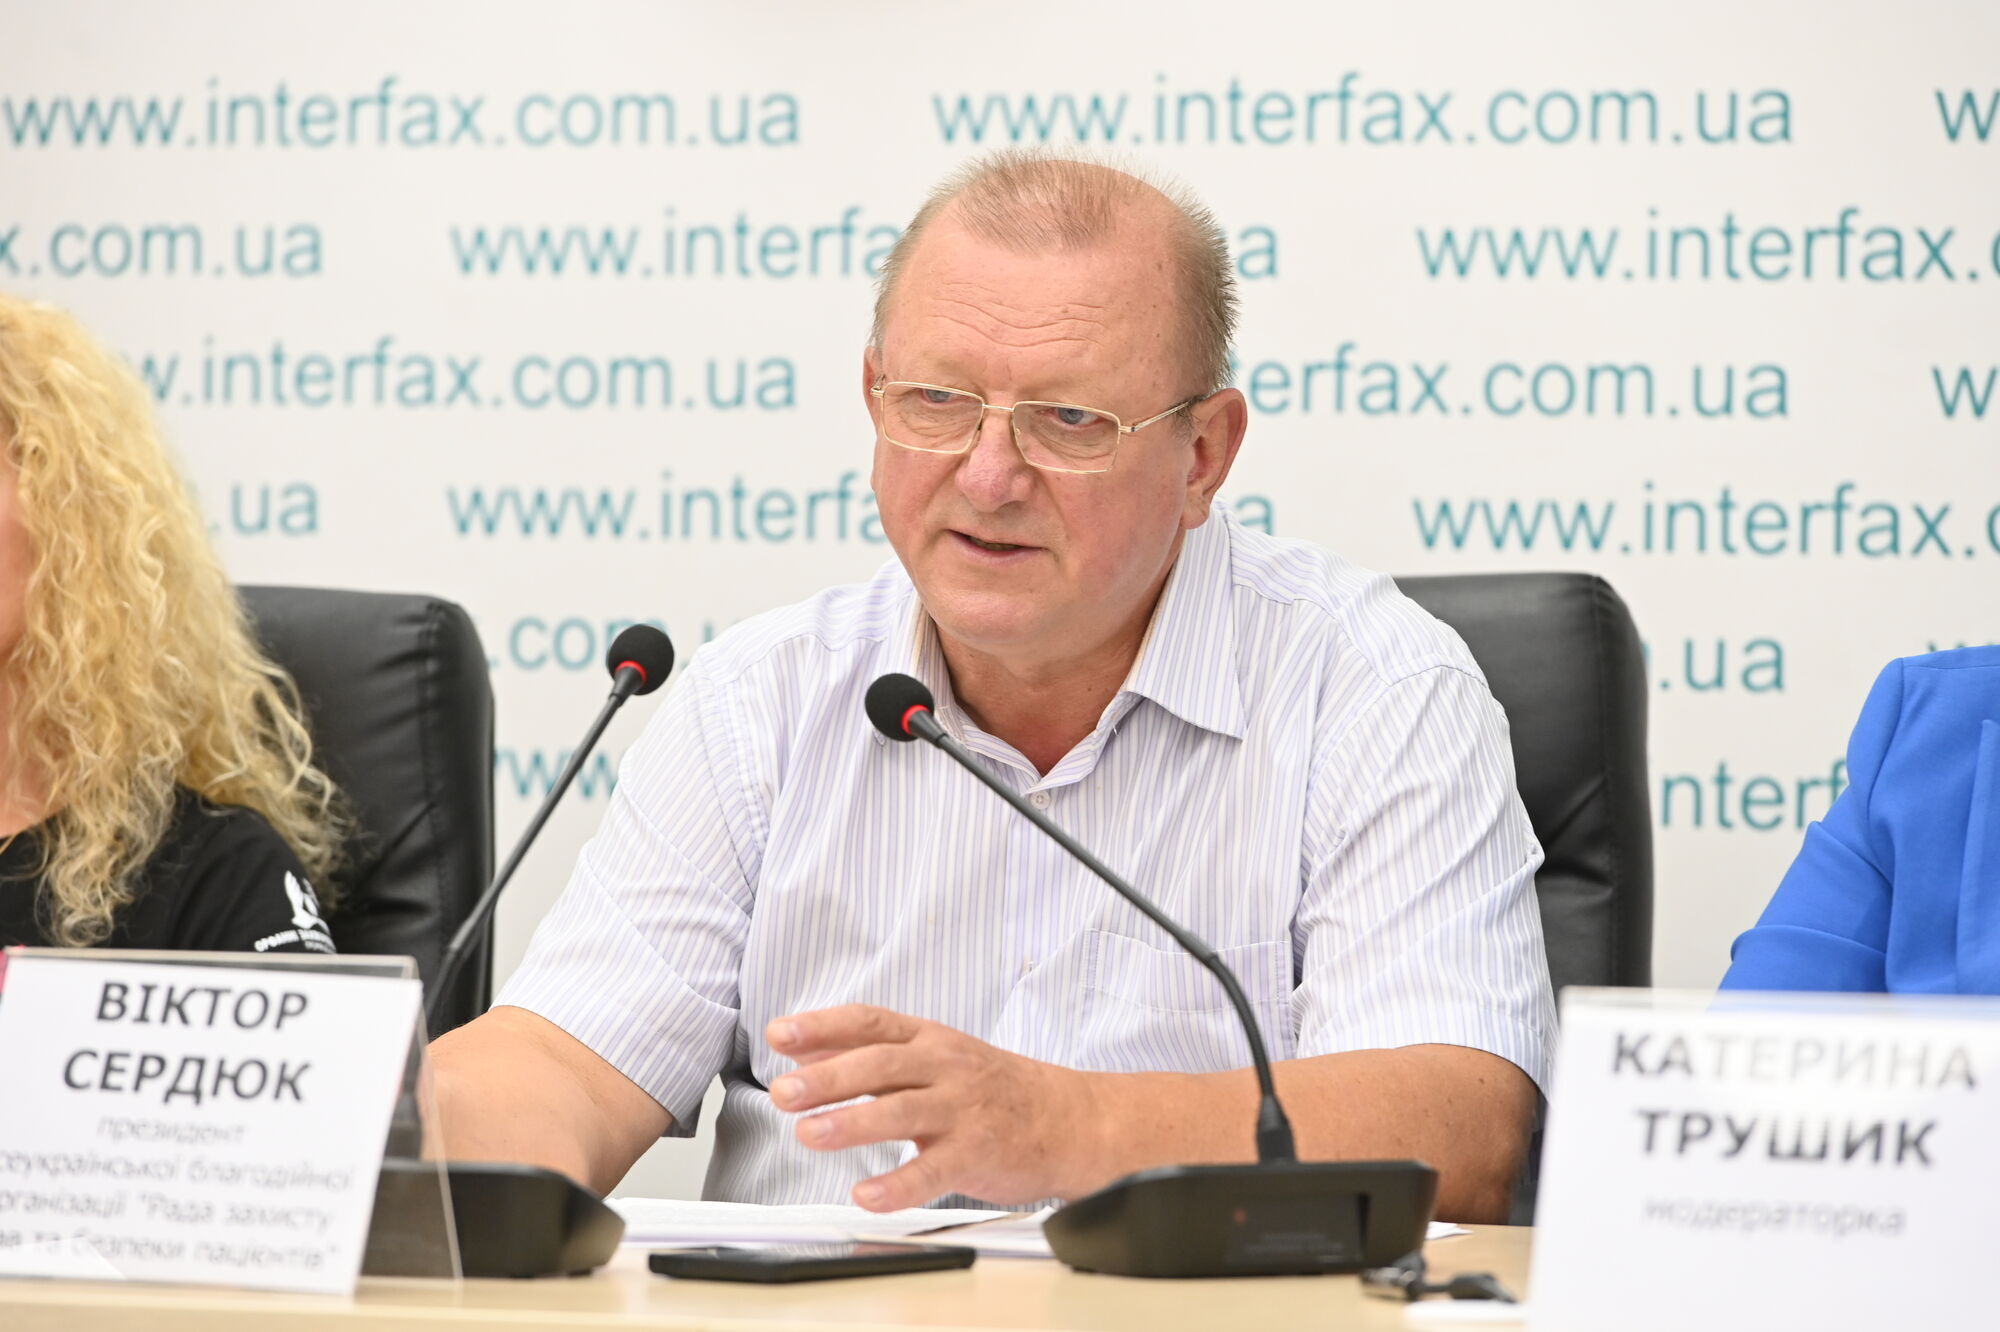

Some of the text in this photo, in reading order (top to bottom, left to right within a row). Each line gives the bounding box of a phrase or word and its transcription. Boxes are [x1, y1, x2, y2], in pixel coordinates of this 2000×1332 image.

[3, 75, 802, 149] www.interfax.com.ua
[930, 71, 1794, 147] www.interfax.com.ua
[1415, 206, 2000, 283] www.interfax.
[1229, 341, 1790, 421] erfax.com.ua
[95, 980, 310, 1032] ВІКТОР
[62, 1047, 312, 1107] СЕРДЮК
[1610, 1030, 1981, 1093] КАТЕРИНА
[1634, 1108, 1938, 1168] ТРУШИК
